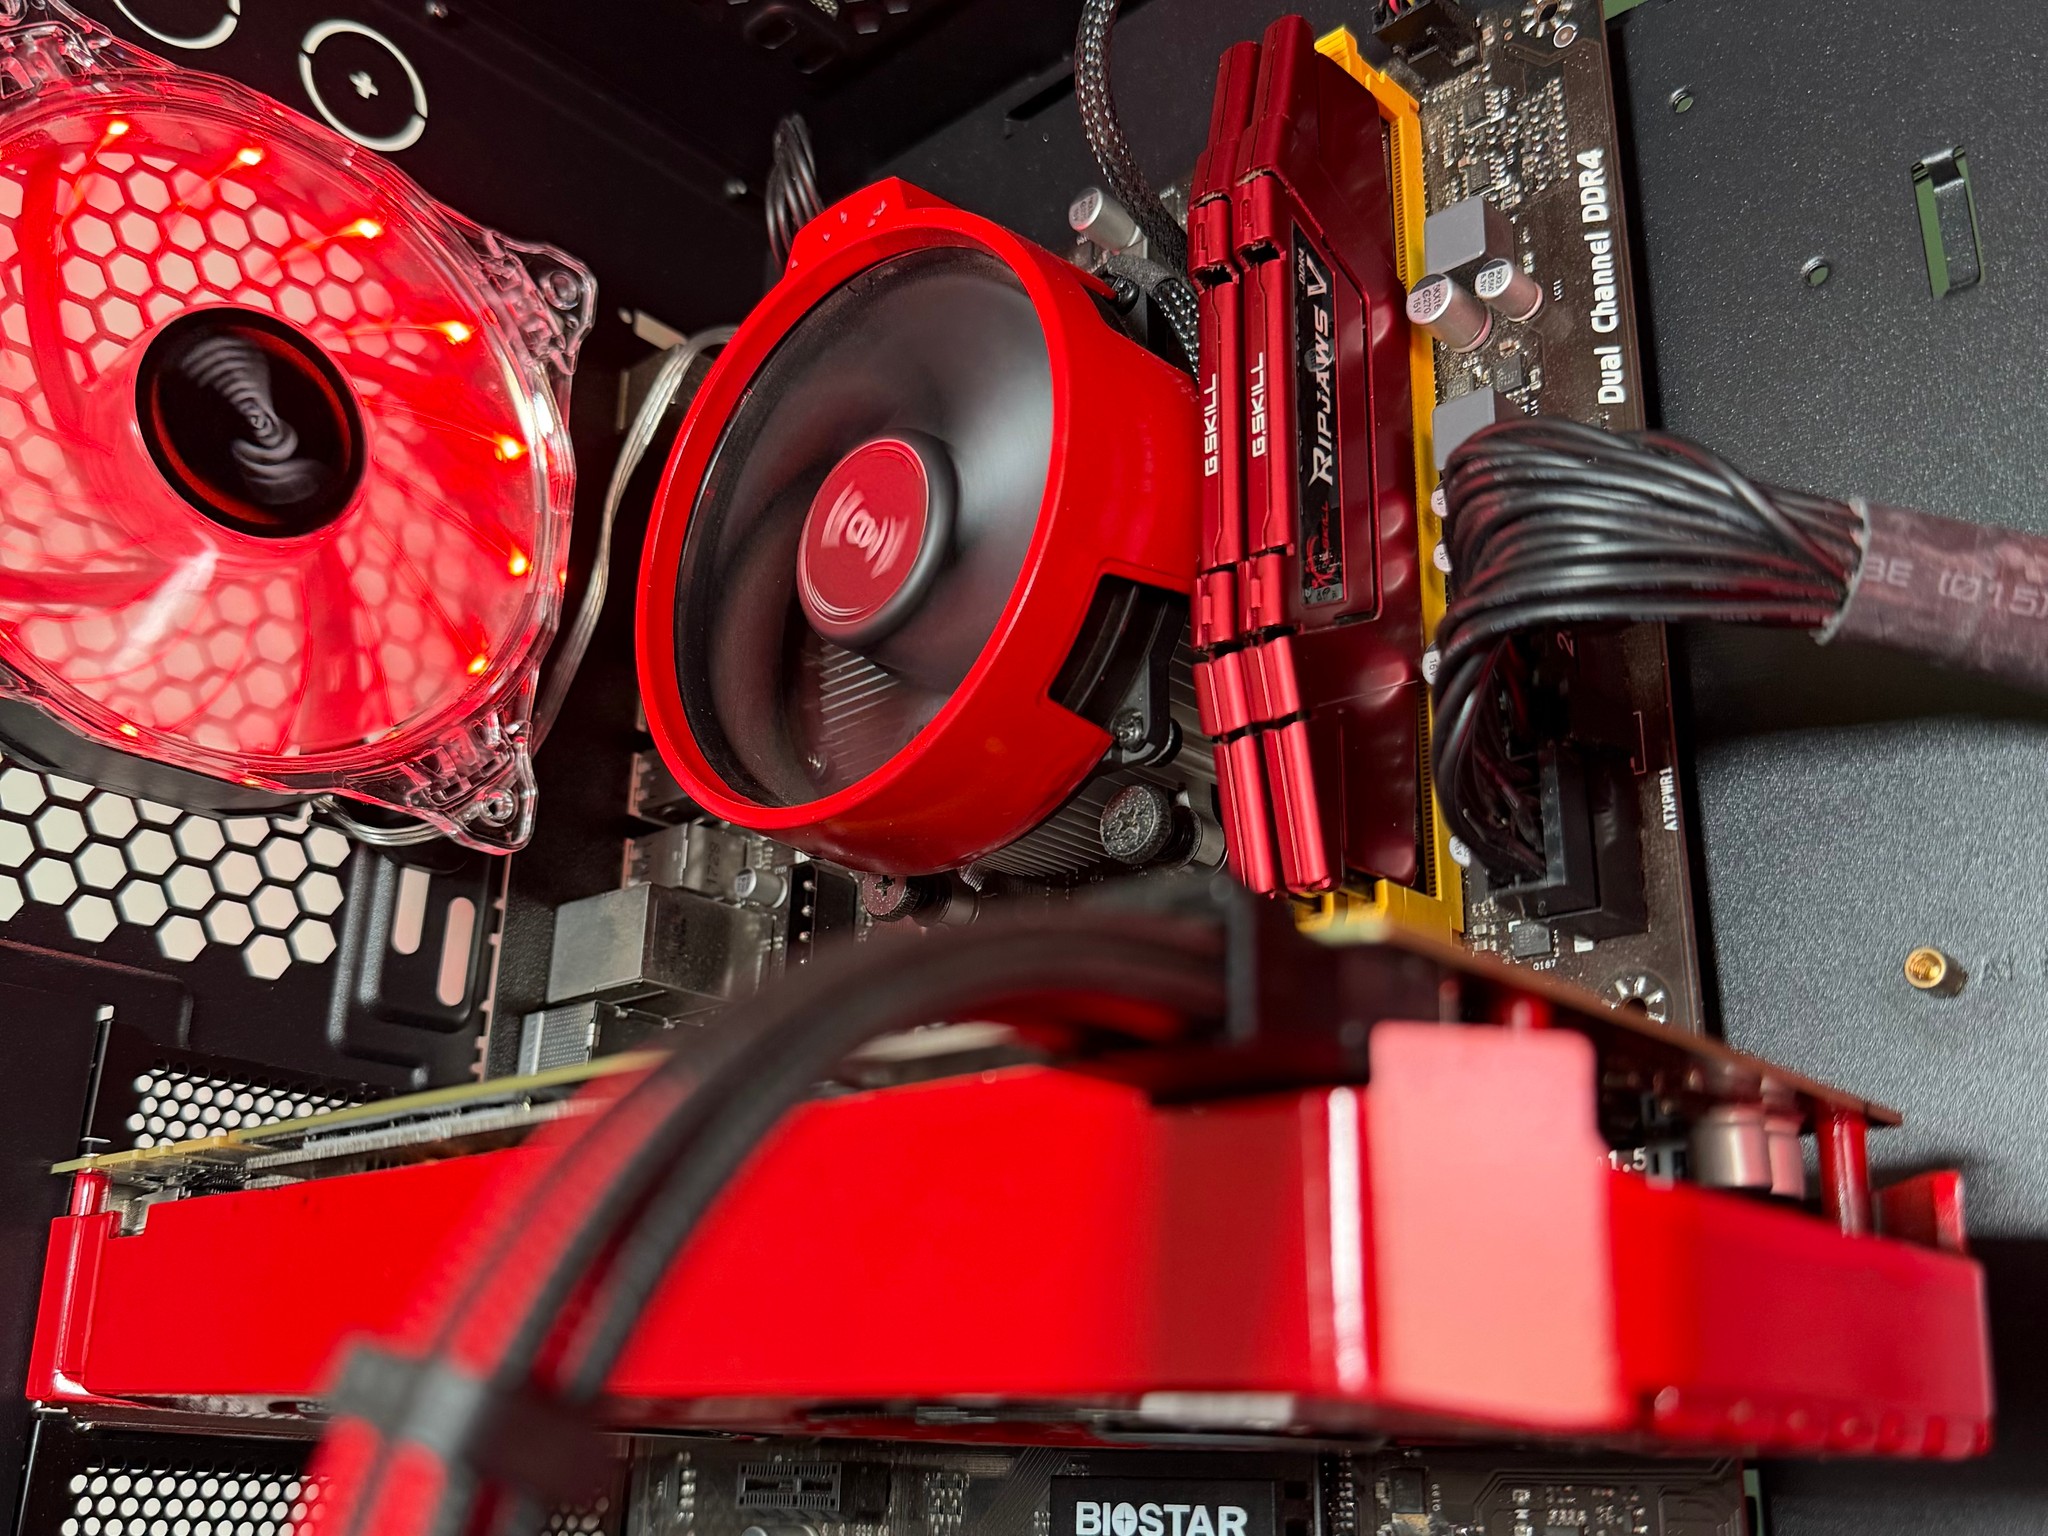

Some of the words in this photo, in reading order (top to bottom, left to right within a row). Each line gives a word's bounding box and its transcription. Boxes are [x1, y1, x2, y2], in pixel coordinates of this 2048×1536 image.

[1576, 149, 1609, 224] DDR4
[1306, 253, 1327, 297] V
[1412, 297, 1422, 314] 16V
[1583, 231, 1618, 334] Channel
[1250, 351, 1266, 458] G.SKILL
[1307, 303, 1334, 487] RIPJAWS
[1593, 345, 1626, 405] Dual
[1203, 373, 1219, 477] G.SKILL
[1658, 766, 1679, 831] ATXPWR1
[1075, 1501, 1249, 1536] BIOSTAR
